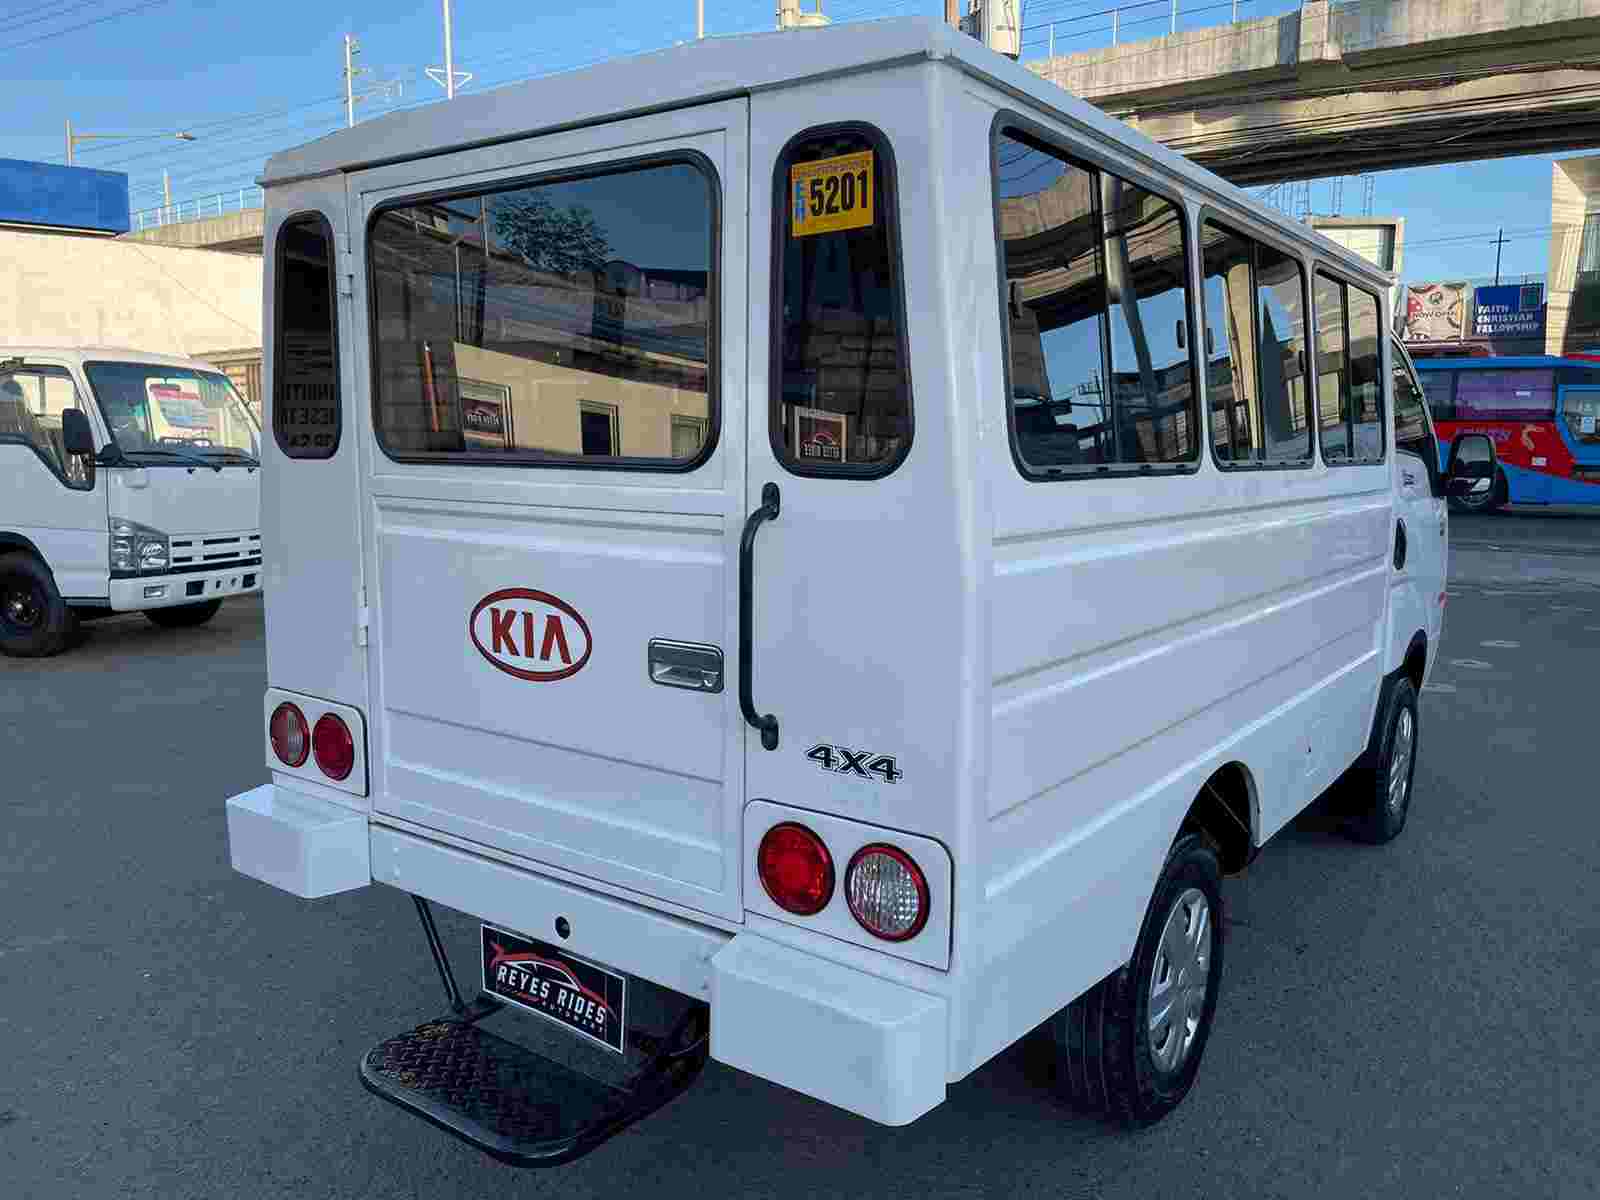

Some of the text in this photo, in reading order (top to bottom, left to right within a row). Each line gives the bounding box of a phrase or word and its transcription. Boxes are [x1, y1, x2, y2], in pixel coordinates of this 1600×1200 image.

[810, 168, 868, 217] 5201
[1414, 310, 1434, 319] NOW
[1476, 304, 1509, 314] FAITH
[1476, 312, 1534, 323] CHRISTIAN
[1476, 322, 1540, 334] FELLOWSHIP
[490, 607, 572, 665] KIA
[497, 965, 606, 1025] REYES RIDES
